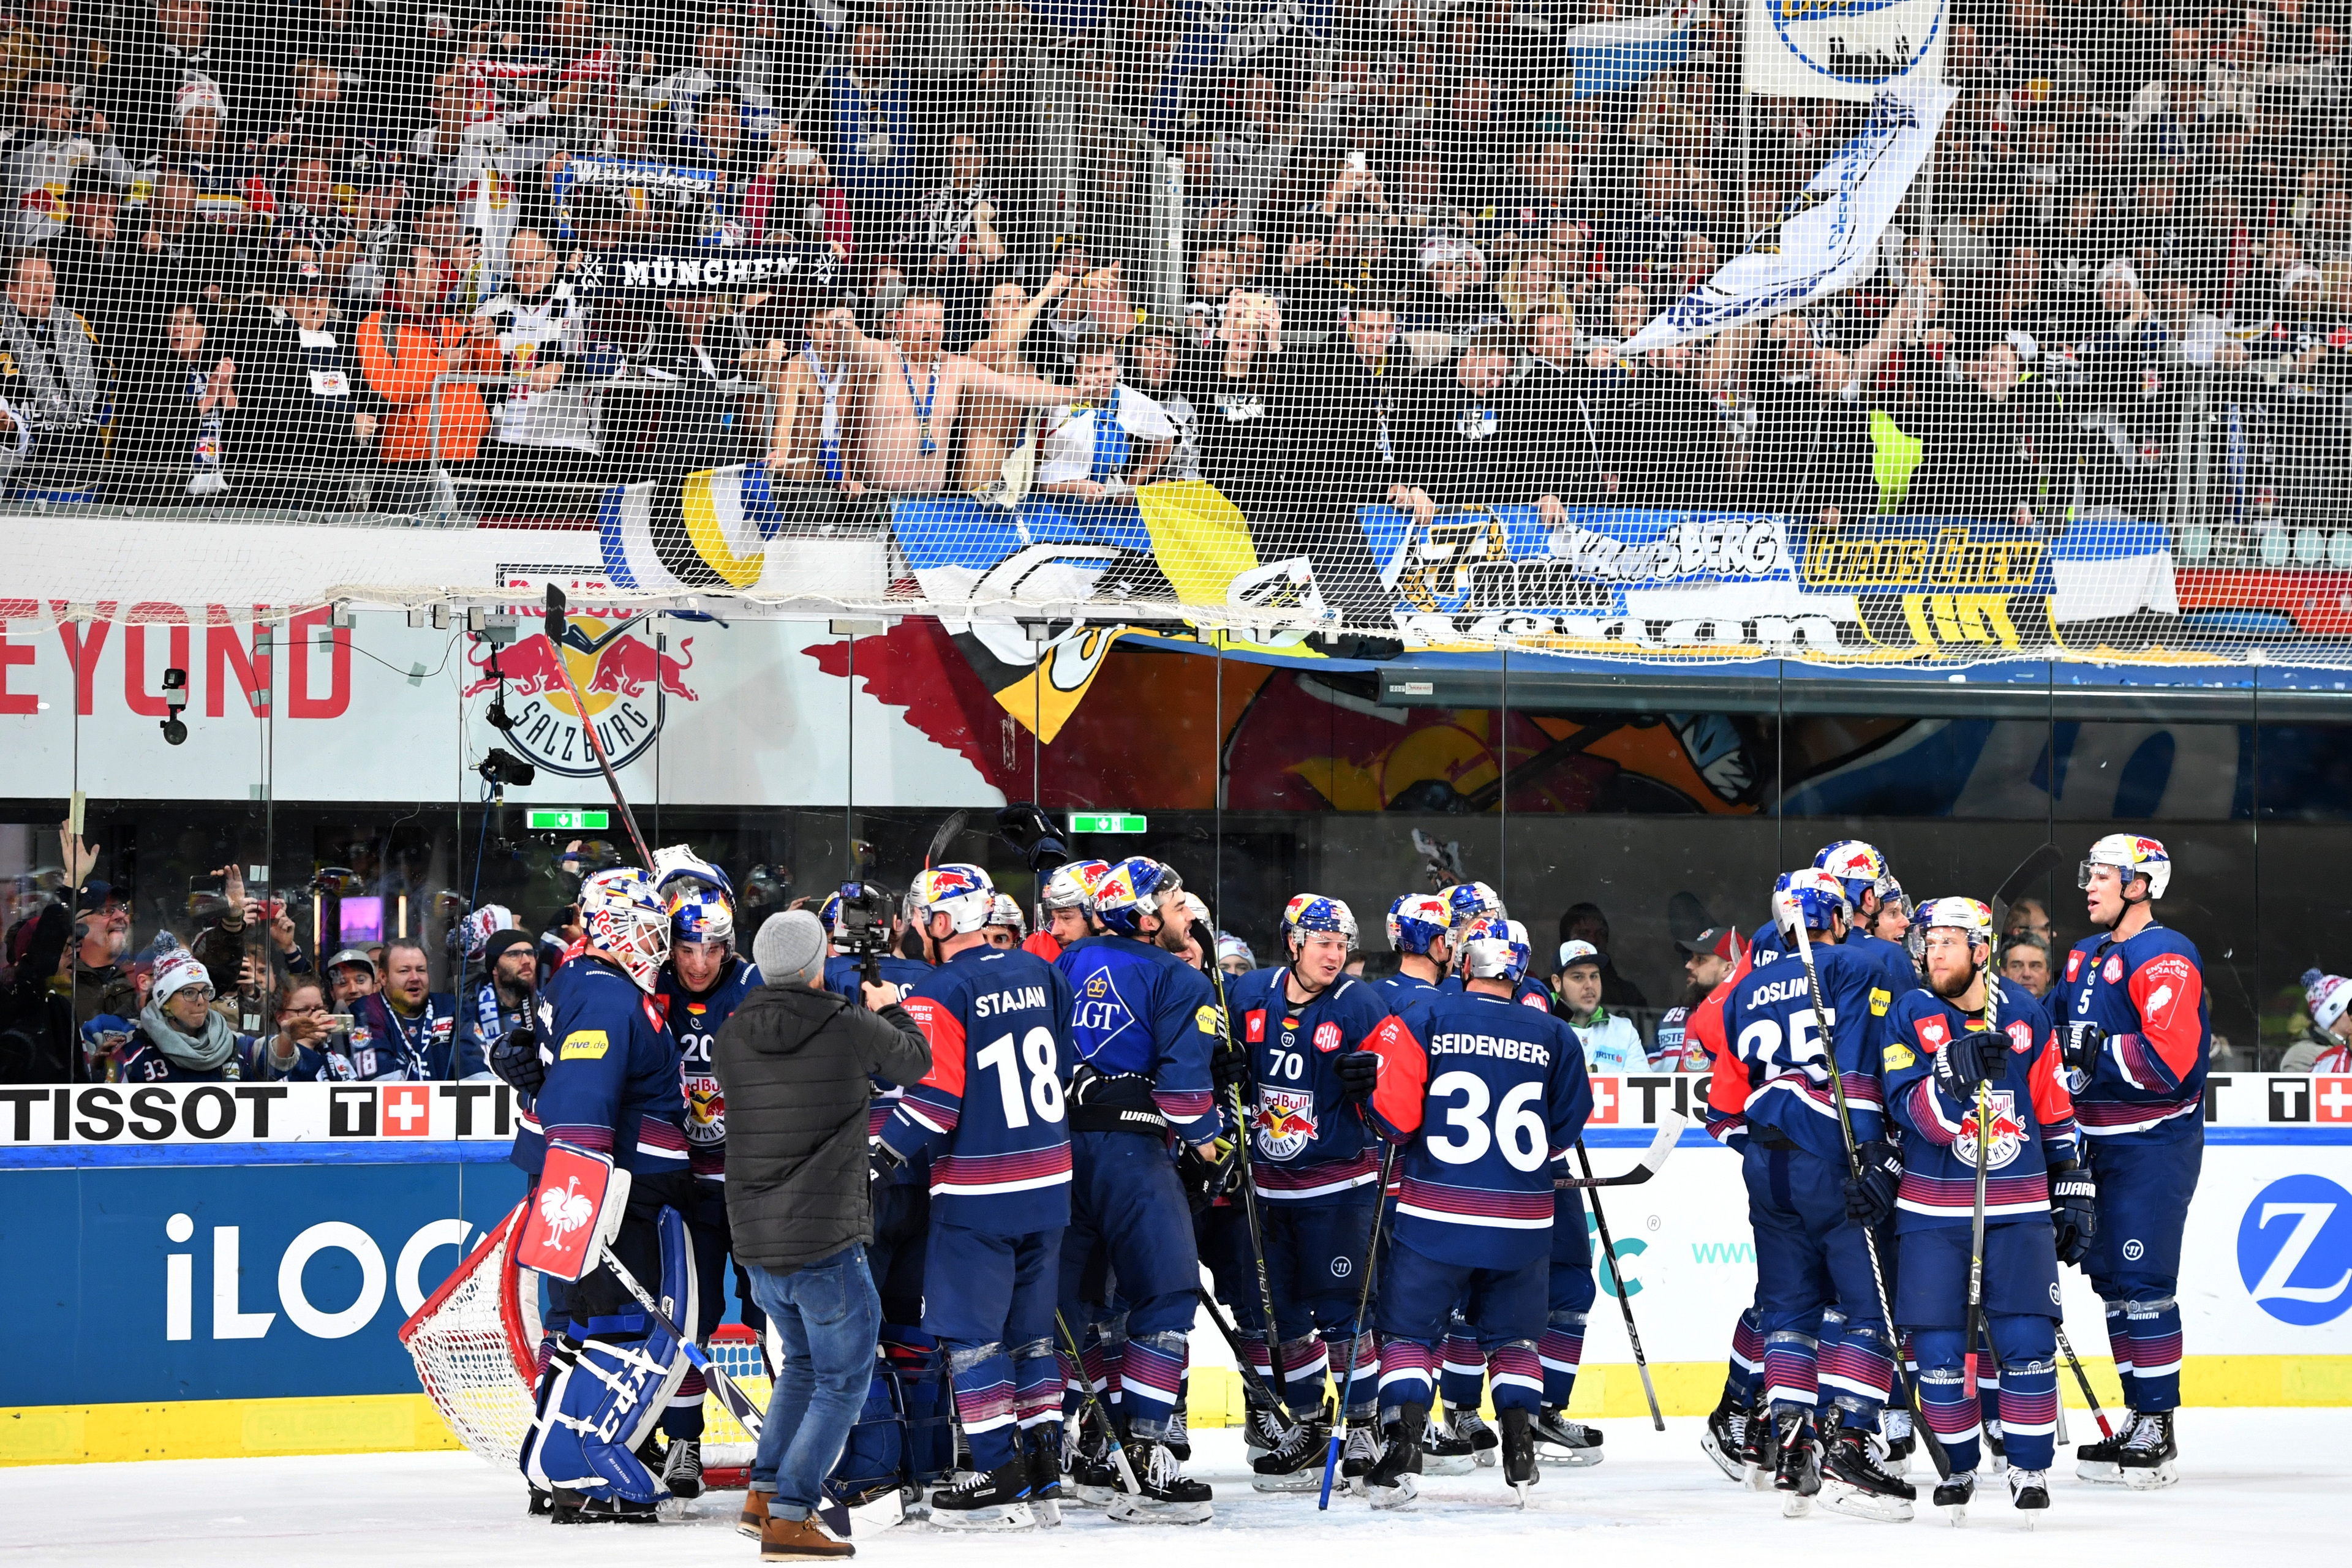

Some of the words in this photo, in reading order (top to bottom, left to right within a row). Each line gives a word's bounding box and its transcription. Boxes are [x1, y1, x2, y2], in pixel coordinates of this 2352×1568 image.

[622, 257, 799, 287] MÜNCHEN
[1806, 527, 1927, 586] CHAOS
[1929, 528, 2045, 586] CREW
[0, 599, 352, 719] EYOND
[513, 700, 649, 763] SALZBURG
[1809, 919, 1819, 927] 25
[976, 986, 1046, 1017] STAJAN
[1746, 976, 1809, 1010] JOSLIN
[2077, 989, 2093, 1014] 5
[1071, 1001, 1120, 1031] LGT
[1663, 1006, 1689, 1022] 85
[680, 1034, 714, 1062] 20
[1315, 1025, 1340, 1050] CHL
[2008, 1024, 2031, 1050] CHL
[144, 1058, 169, 1082] 93
[353, 1048, 377, 1079] 18
[976, 1026, 1065, 1129] 18
[1269, 1049, 1304, 1080] 70
[0, 1086, 288, 1142] TISSOT
[1261, 1091, 1281, 1105] Red
[1281, 1093, 1307, 1108] Bull
[1426, 1070, 1550, 1173] 36
[1261, 1136, 1297, 1155] MÜNCHEN
[1961, 1140, 2013, 1161] MÜCHEN
[1554, 1178, 1607, 1188] BAUER
[2249, 1202, 2352, 1304] Z
[165, 1212, 488, 1340] iLOC
[1257, 1259, 1272, 1315] ALPHA
[636, 1294, 655, 1313] PRO
[1291, 1453, 1308, 1466] CCM
